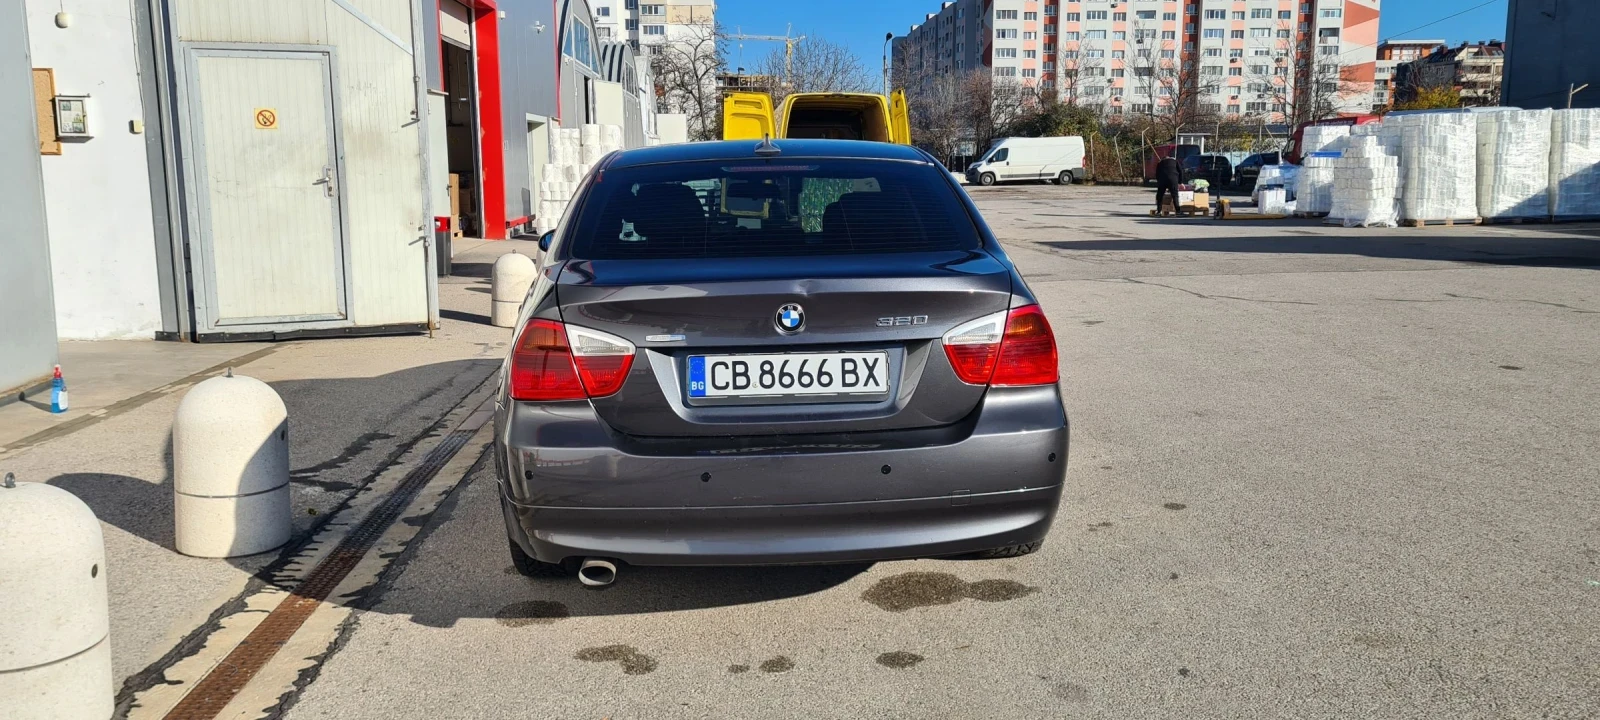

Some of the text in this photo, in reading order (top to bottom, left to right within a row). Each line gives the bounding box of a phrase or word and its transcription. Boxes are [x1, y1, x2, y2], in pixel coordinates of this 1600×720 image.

[876, 314, 929, 328] 320
[710, 357, 881, 391] CB 8666 BX
[691, 381, 704, 391] BG
